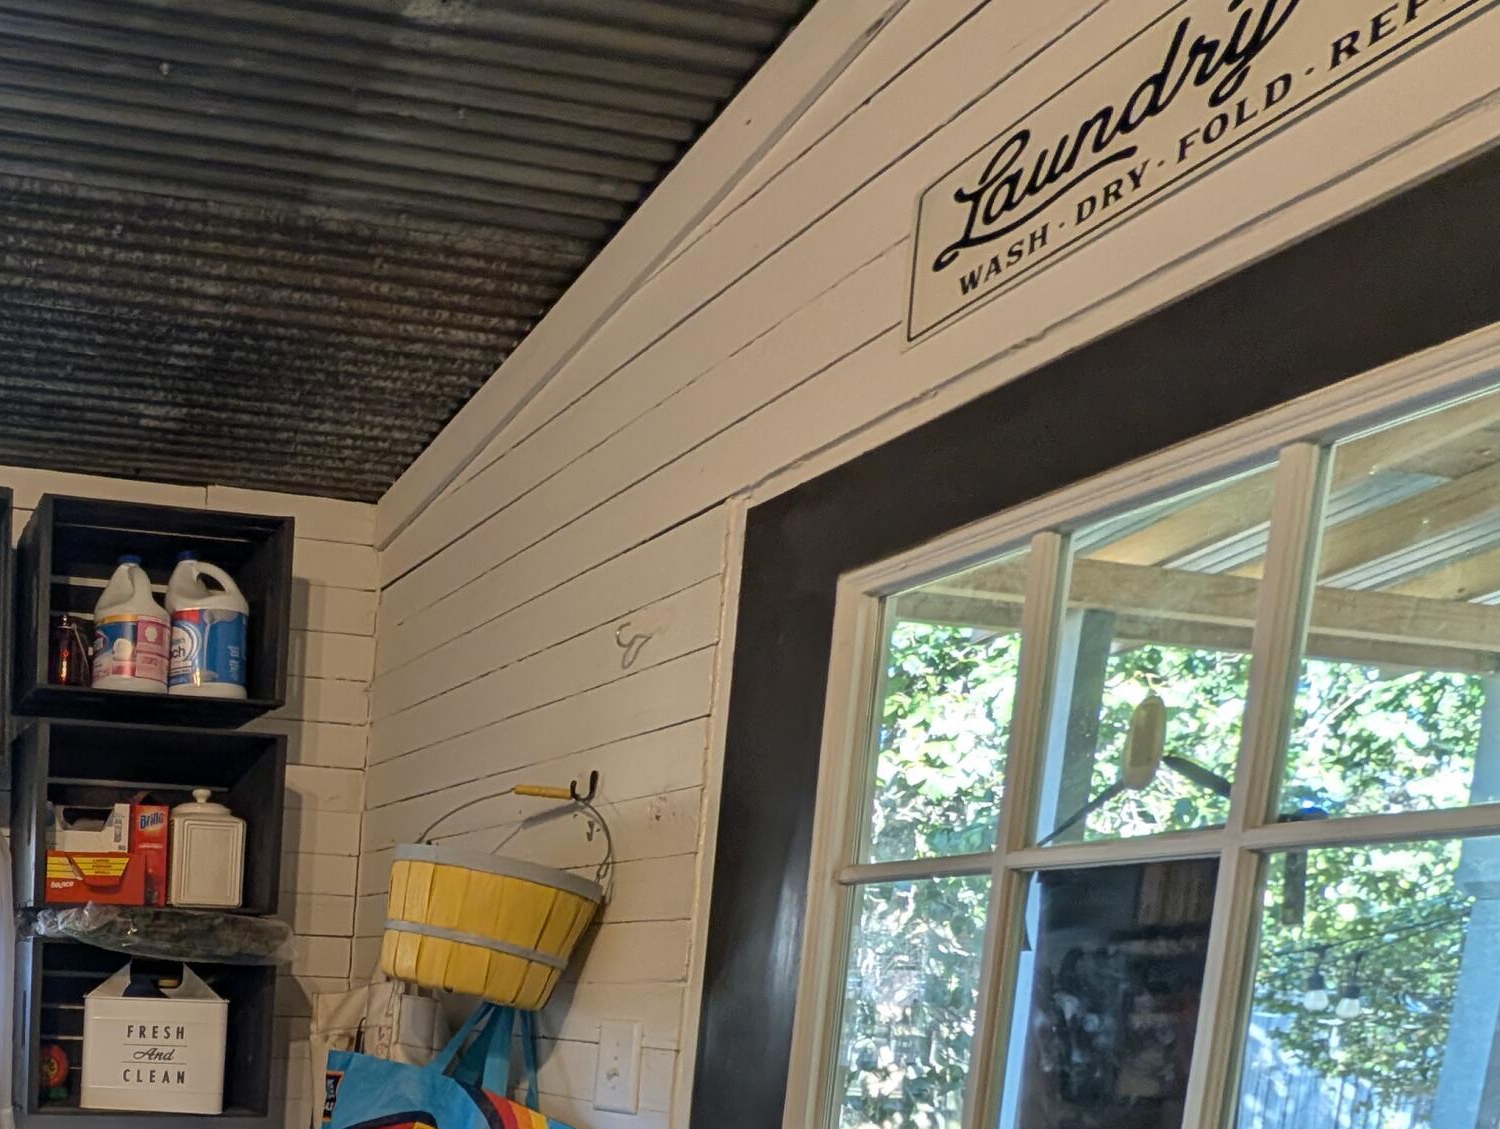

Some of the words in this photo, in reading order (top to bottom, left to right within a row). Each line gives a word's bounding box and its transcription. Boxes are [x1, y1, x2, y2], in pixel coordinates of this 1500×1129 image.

[932, 0, 1304, 272] Laundry
[959, 221, 1051, 296] WASH
[1074, 158, 1151, 227] DRY
[1176, 72, 1293, 164] FOLD
[139, 811, 165, 829] Brillo
[126, 1024, 185, 1040] FRESH
[132, 1047, 176, 1061] And
[123, 1068, 185, 1084] CLEAN
